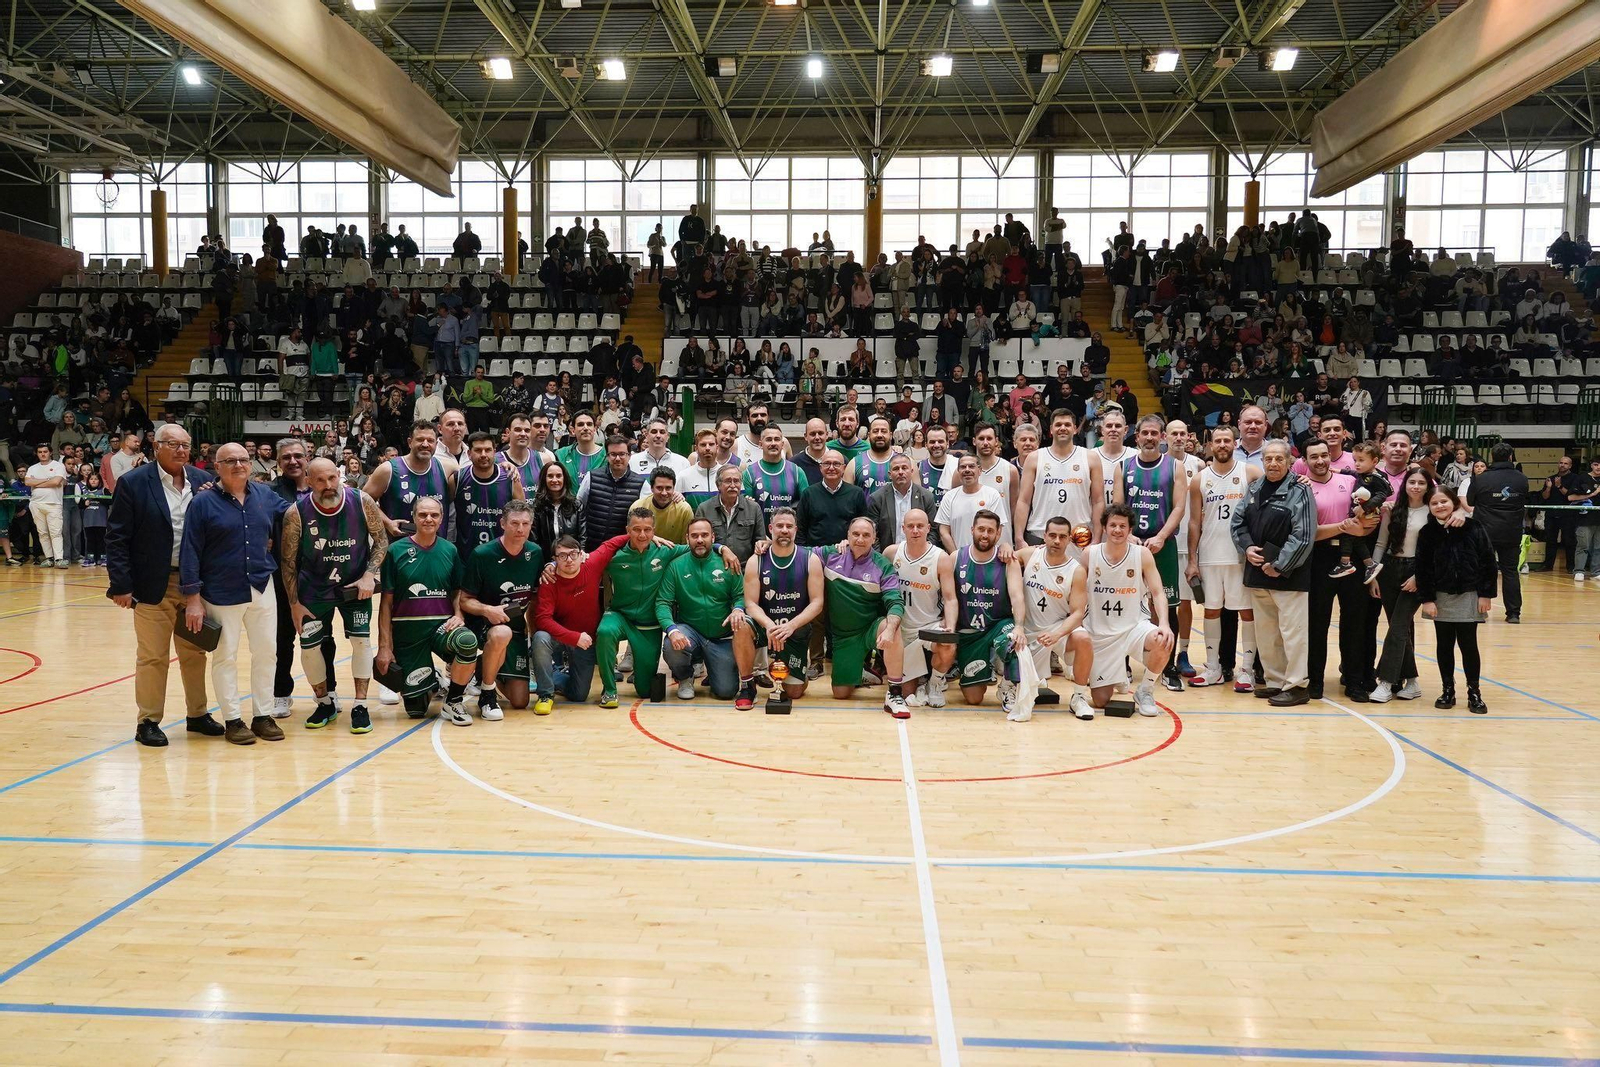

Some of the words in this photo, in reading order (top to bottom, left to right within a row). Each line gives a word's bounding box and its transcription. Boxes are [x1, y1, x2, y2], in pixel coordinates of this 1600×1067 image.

[769, 494, 792, 502] Unicaja
[1058, 489, 1067, 503] 9
[1138, 489, 1164, 499] Unicaja
[1205, 493, 1244, 503] AUTOHERO
[1131, 501, 1160, 510] málaga
[477, 506, 503, 516] Unicaja
[1218, 504, 1231, 520] 13
[471, 519, 498, 529] málaga
[1138, 515, 1150, 530] 5
[479, 531, 490, 545] 9
[329, 567, 342, 583] 4
[898, 578, 932, 590] TOHERO
[425, 588, 448, 597] Unicaja
[972, 586, 1000, 596] Unicaja
[1026, 580, 1064, 599] AUTOHERO
[1093, 586, 1137, 595] AUTOHERO
[775, 591, 801, 601] Unicaja
[902, 590, 912, 607] 11
[966, 599, 994, 609] málaga
[1037, 596, 1048, 613] 4
[1101, 599, 1124, 616] 44
[769, 605, 796, 615] málaga
[970, 613, 985, 630] 41
